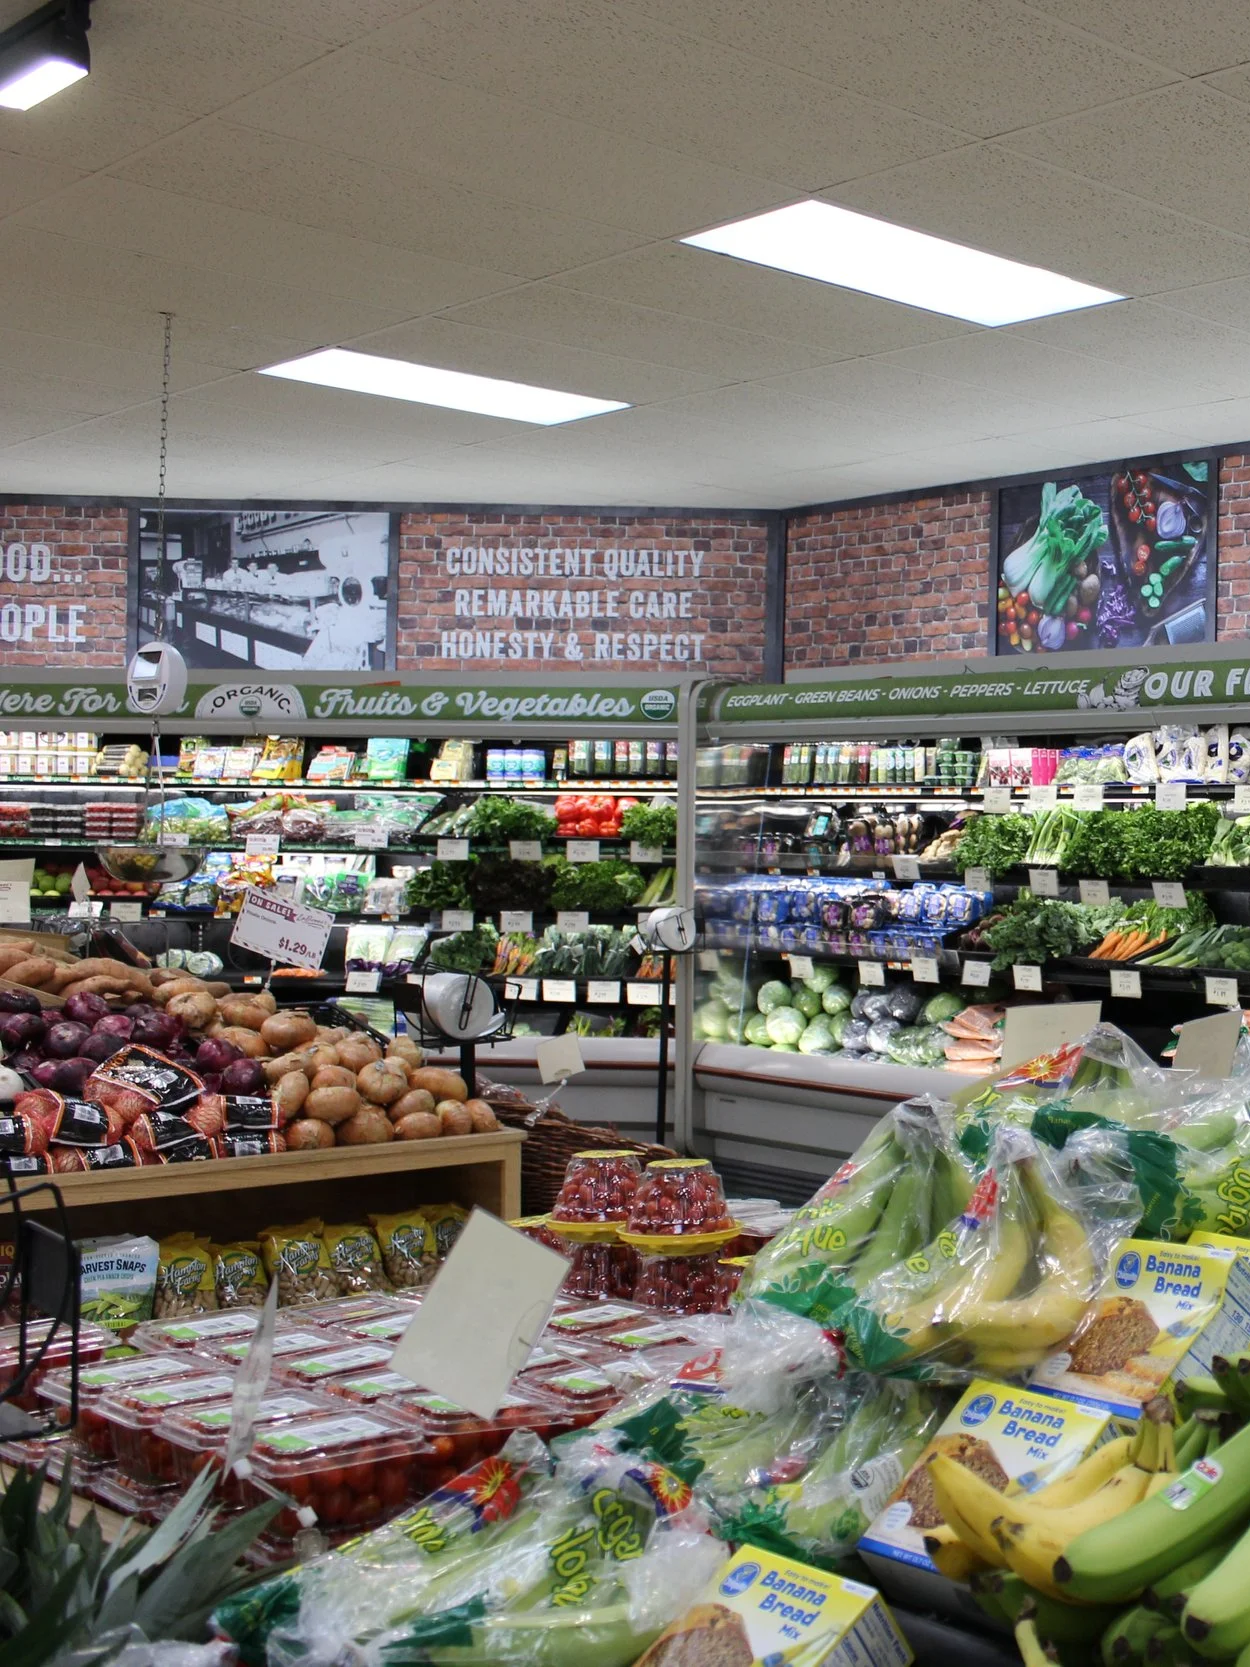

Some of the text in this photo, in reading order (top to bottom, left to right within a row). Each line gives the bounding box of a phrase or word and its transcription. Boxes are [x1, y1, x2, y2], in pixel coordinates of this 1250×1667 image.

[0, 543, 83, 583] OD...
[446, 547, 705, 580] CONSISTENT QUALITY
[454, 588, 694, 619] REMARKABLE CARE
[441, 630, 705, 662] HONESTY & RESPECT
[726, 693, 787, 708] EGGPLANT
[794, 691, 837, 705] GREEN
[836, 687, 880, 702] BEANS
[888, 685, 941, 700] ONIONS
[950, 682, 1013, 698] PEPPERS
[1023, 679, 1091, 696] LETTUCE
[1143, 669, 1214, 699] OUR
[0, 688, 55, 717] ere
[58, 687, 121, 717] For
[212, 685, 291, 710] ORGANIC
[313, 688, 636, 721] Fruits & Vegetables
[648, 695, 668, 703] USDA
[251, 895, 263, 905] ON
[265, 900, 291, 916] SALE!
[80, 1258, 147, 1276] ARVEST SNAPS
[1145, 1255, 1202, 1277] Banana
[1159, 1250, 1174, 1260] Easy
[1153, 1276, 1203, 1299] Bread
[1175, 1299, 1195, 1312] Mix
[1231, 1309, 1244, 1323] 130
[998, 1400, 1065, 1430] Banana
[1018, 1398, 1035, 1408] Easy
[1002, 1420, 1063, 1448] Bread
[1026, 1446, 1049, 1460] Mix
[1196, 1461, 1219, 1479] Dole
[759, 1570, 828, 1607] Banana
[757, 1593, 820, 1628] Bread
[777, 1623, 803, 1641] Mix
